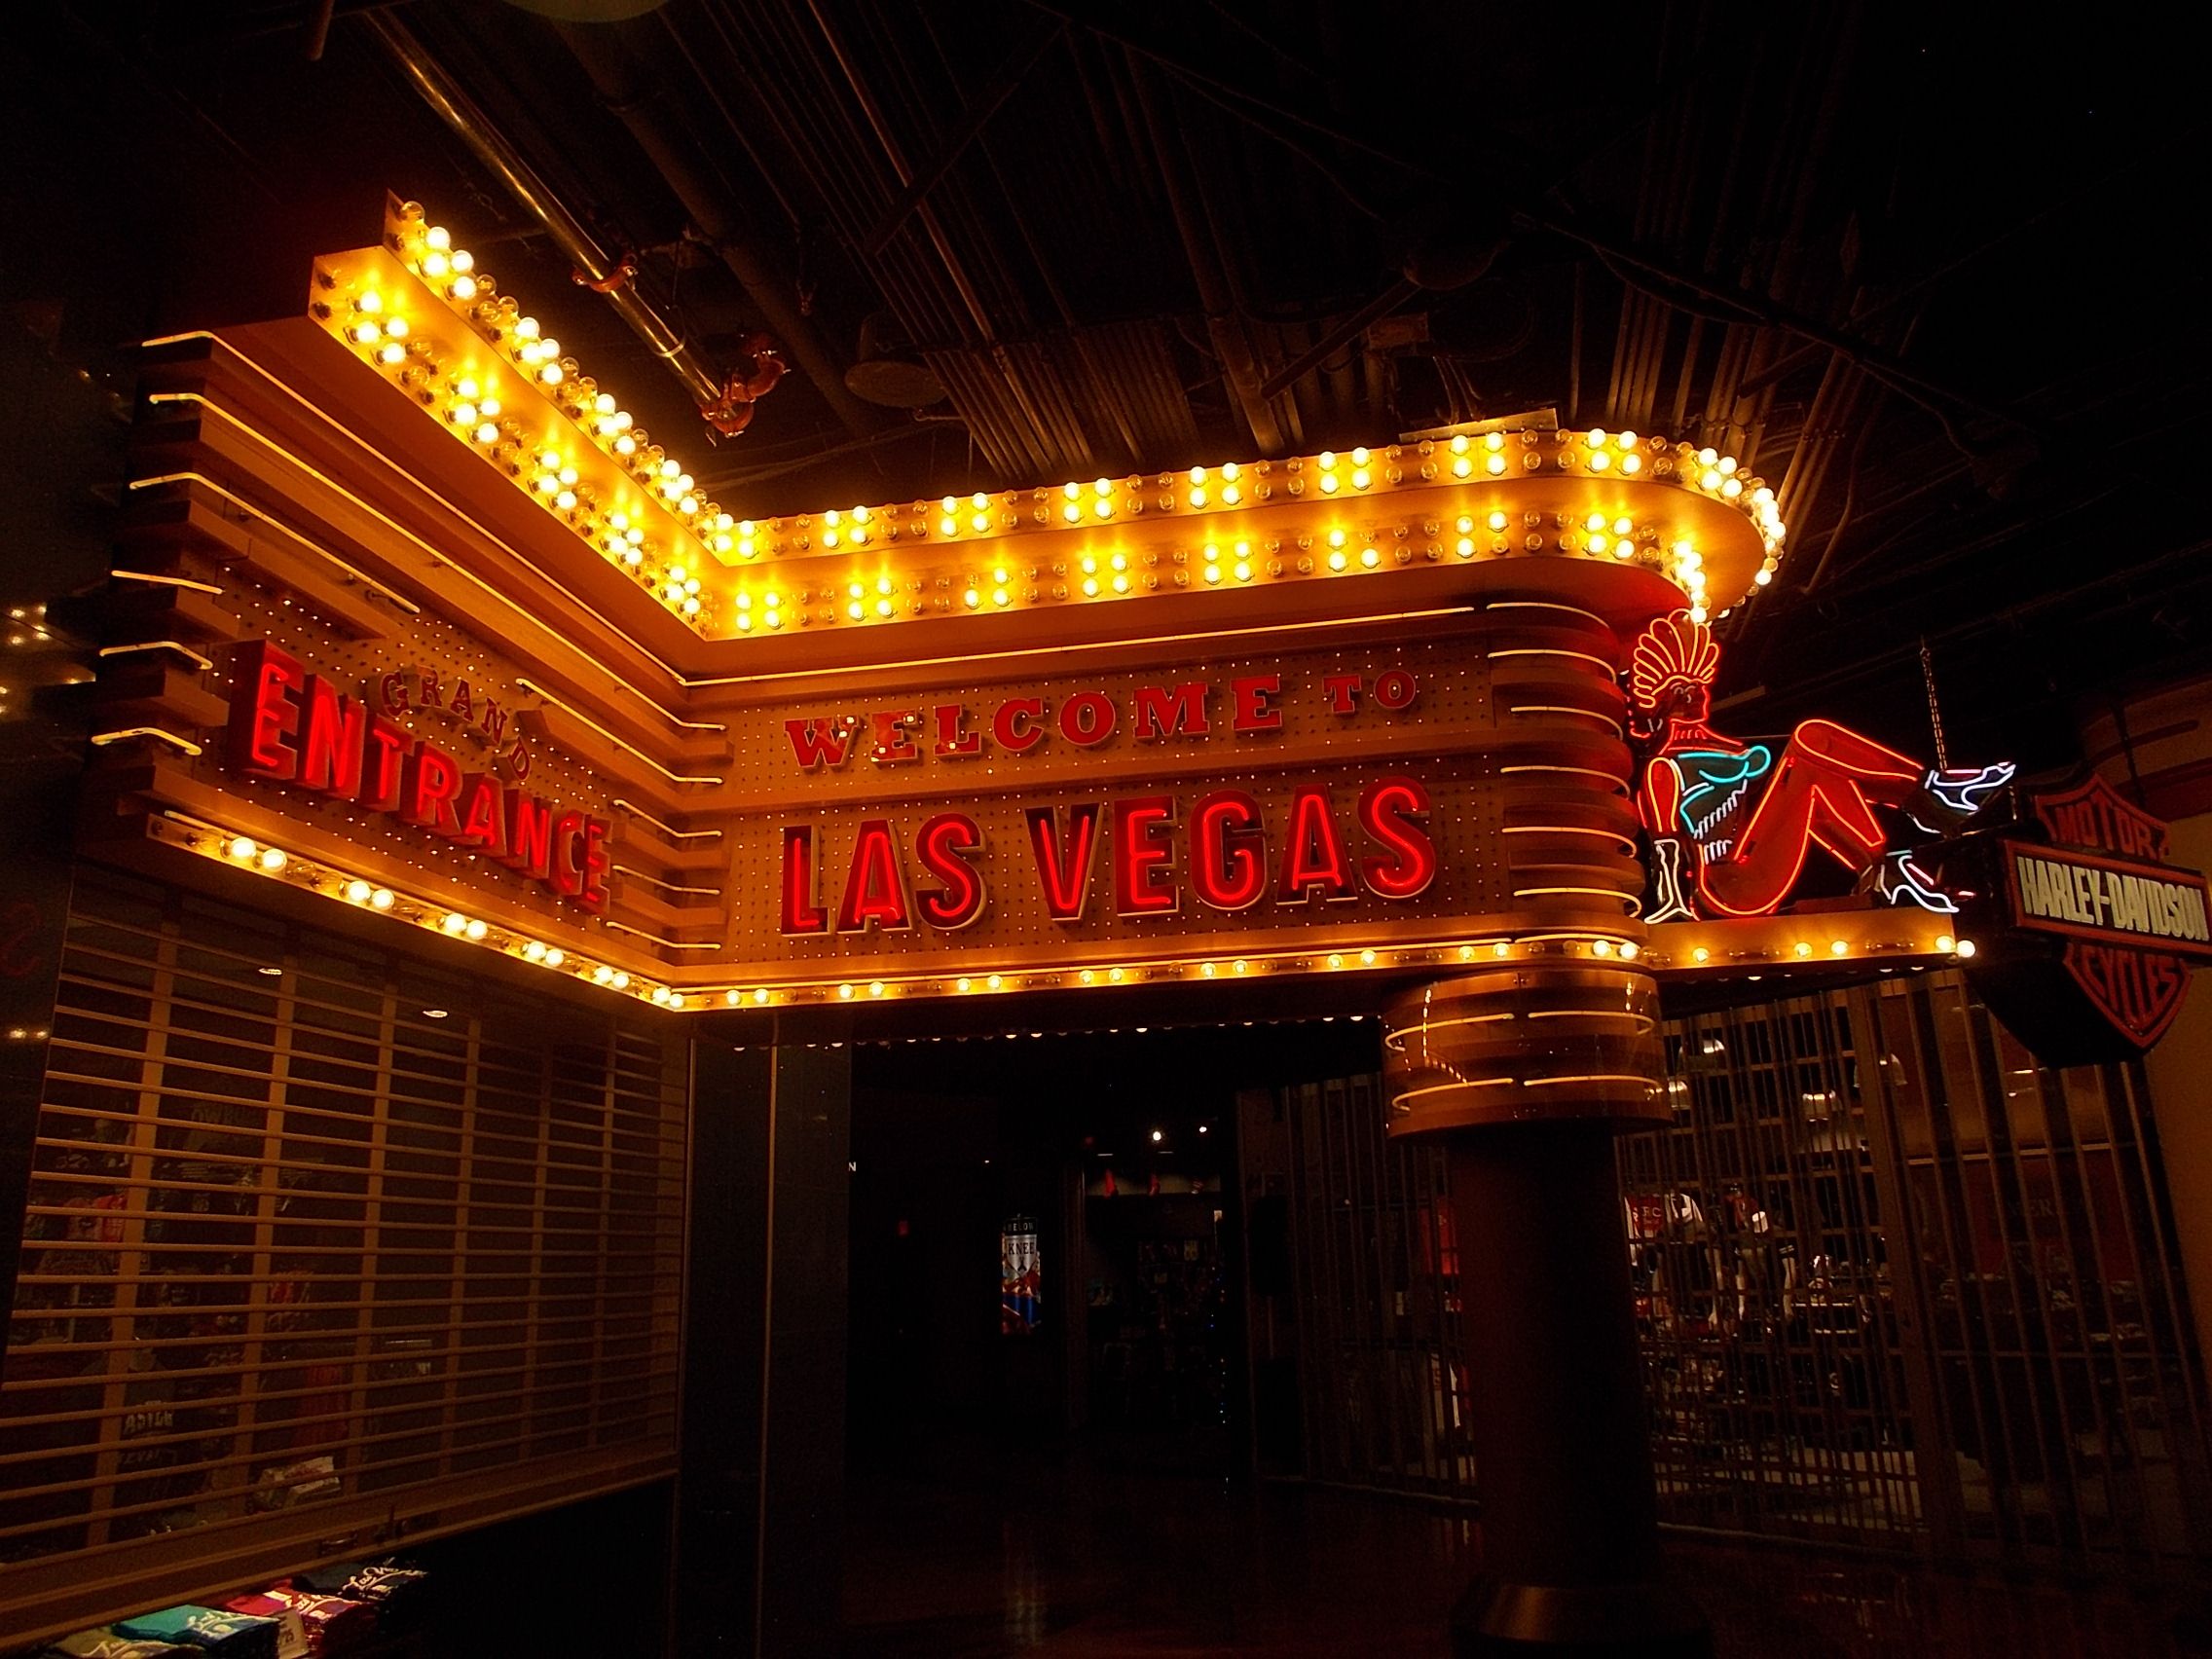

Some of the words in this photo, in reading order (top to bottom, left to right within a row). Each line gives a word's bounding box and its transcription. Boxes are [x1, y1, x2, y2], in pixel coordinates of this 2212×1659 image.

[381, 665, 532, 781] GRAND
[785, 676, 1282, 766] WELCOME
[1323, 669, 1418, 714] TO
[236, 639, 612, 915] ENTRANCE
[2054, 788, 2159, 861] MOTOR
[780, 812, 986, 937] LAS
[1024, 775, 1437, 921] VEGAS
[2016, 856, 2209, 942] HARLEY-DAVIDSON
[1008, 1242, 1035, 1255] KNEE
